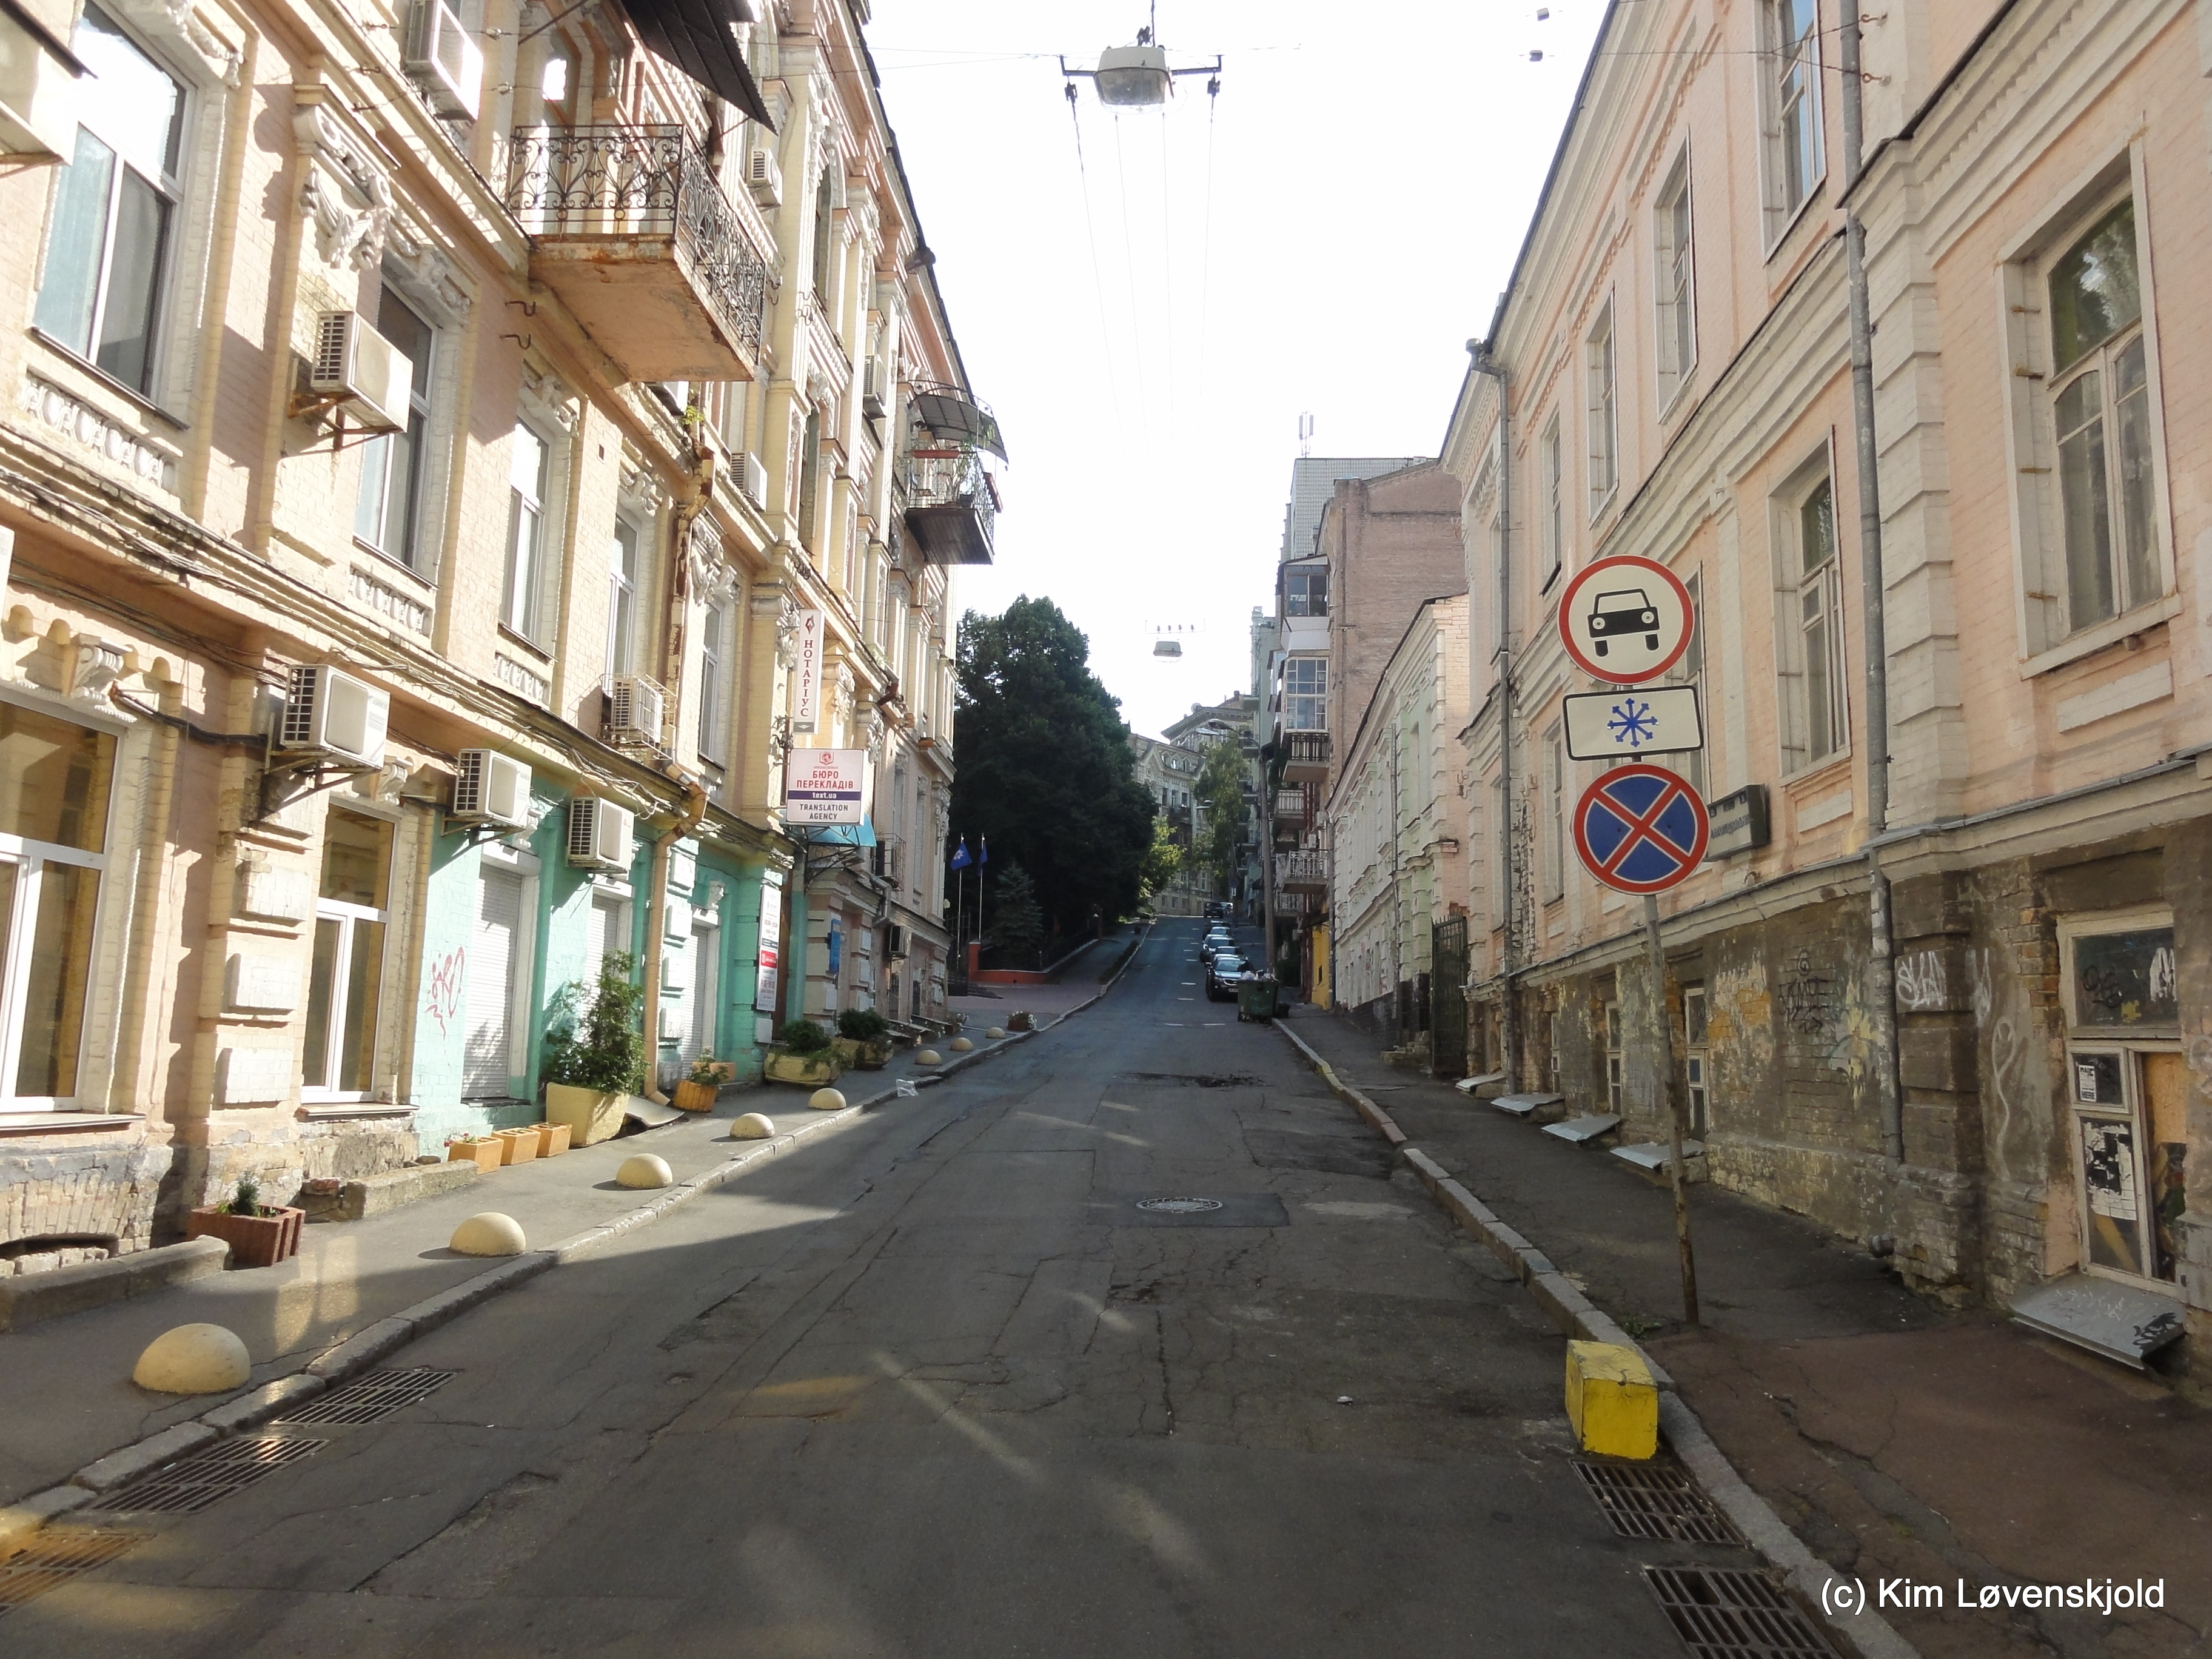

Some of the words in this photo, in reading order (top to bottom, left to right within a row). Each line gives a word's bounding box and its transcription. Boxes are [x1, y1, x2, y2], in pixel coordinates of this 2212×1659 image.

[800, 640, 814, 717] НОТАРІУС
[813, 770, 839, 779] БЮРО
[796, 780, 854, 790] ПЕРЕКЛАДІВ
